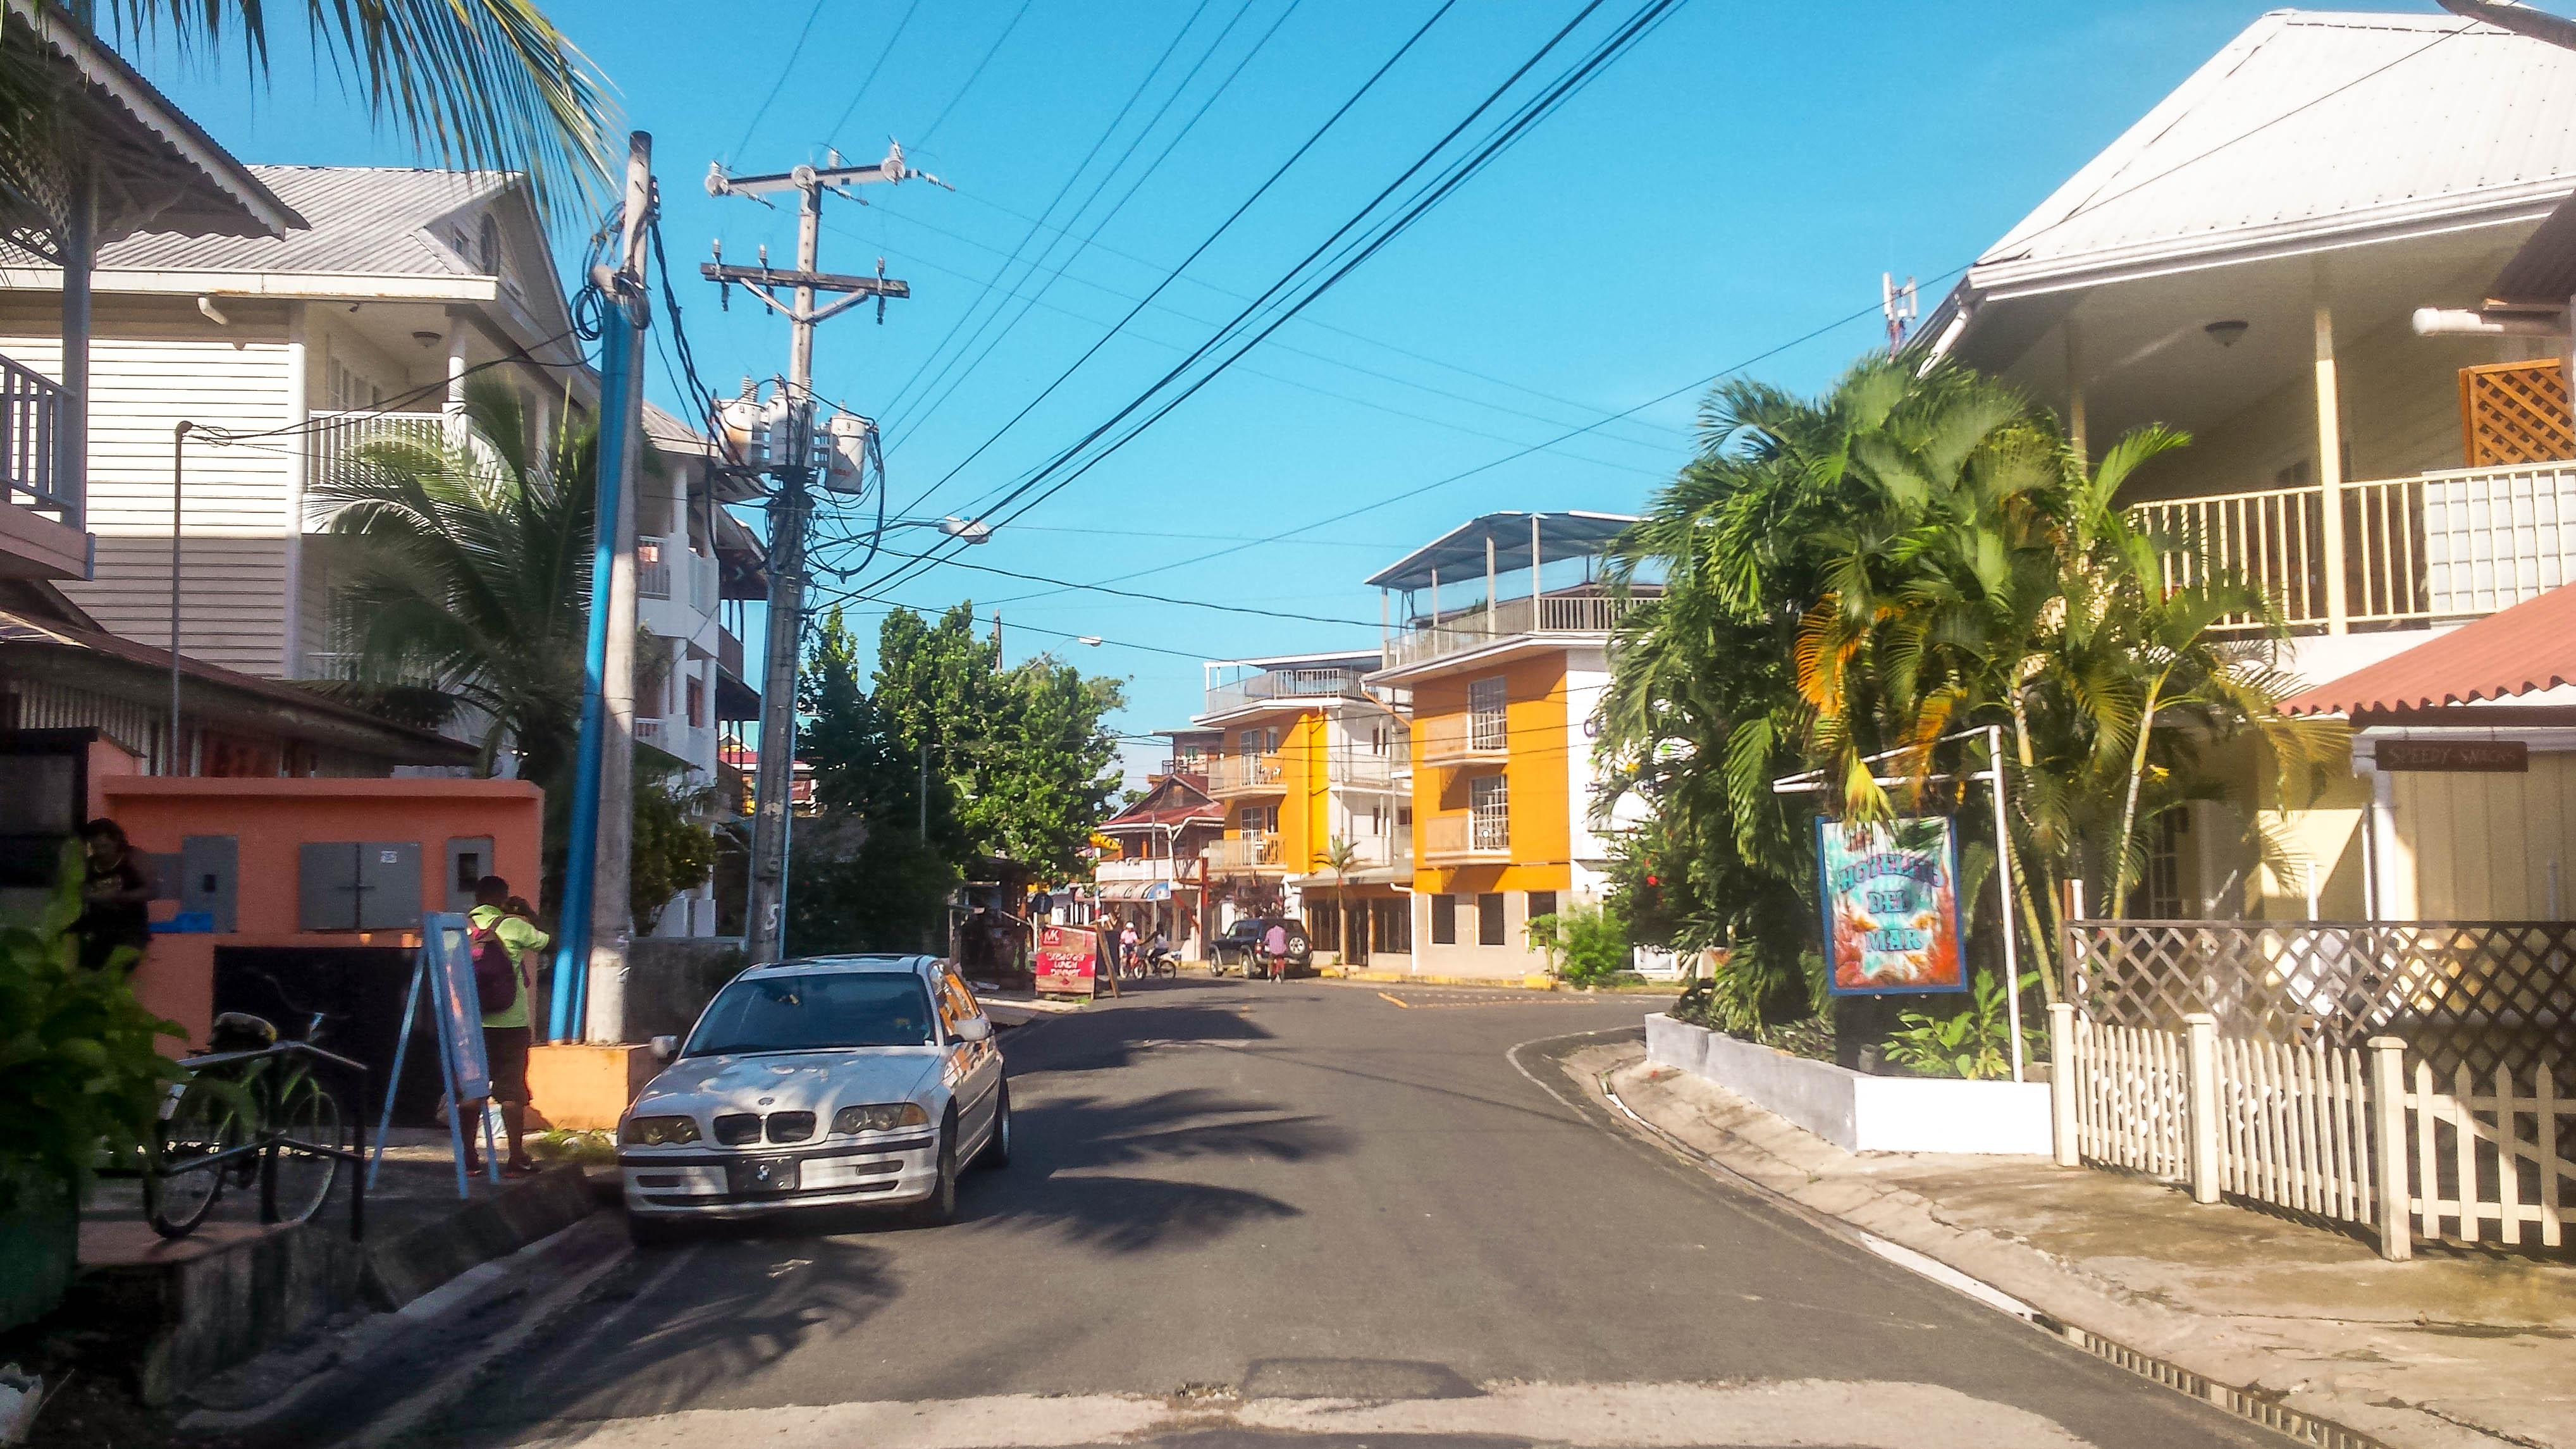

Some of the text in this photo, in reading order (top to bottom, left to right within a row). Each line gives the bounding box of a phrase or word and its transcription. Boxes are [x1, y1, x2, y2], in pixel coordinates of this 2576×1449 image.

[2388, 745, 2451, 765] SPEEDY
[1867, 889, 1911, 913] DEL
[1864, 927, 1923, 951] MAR
